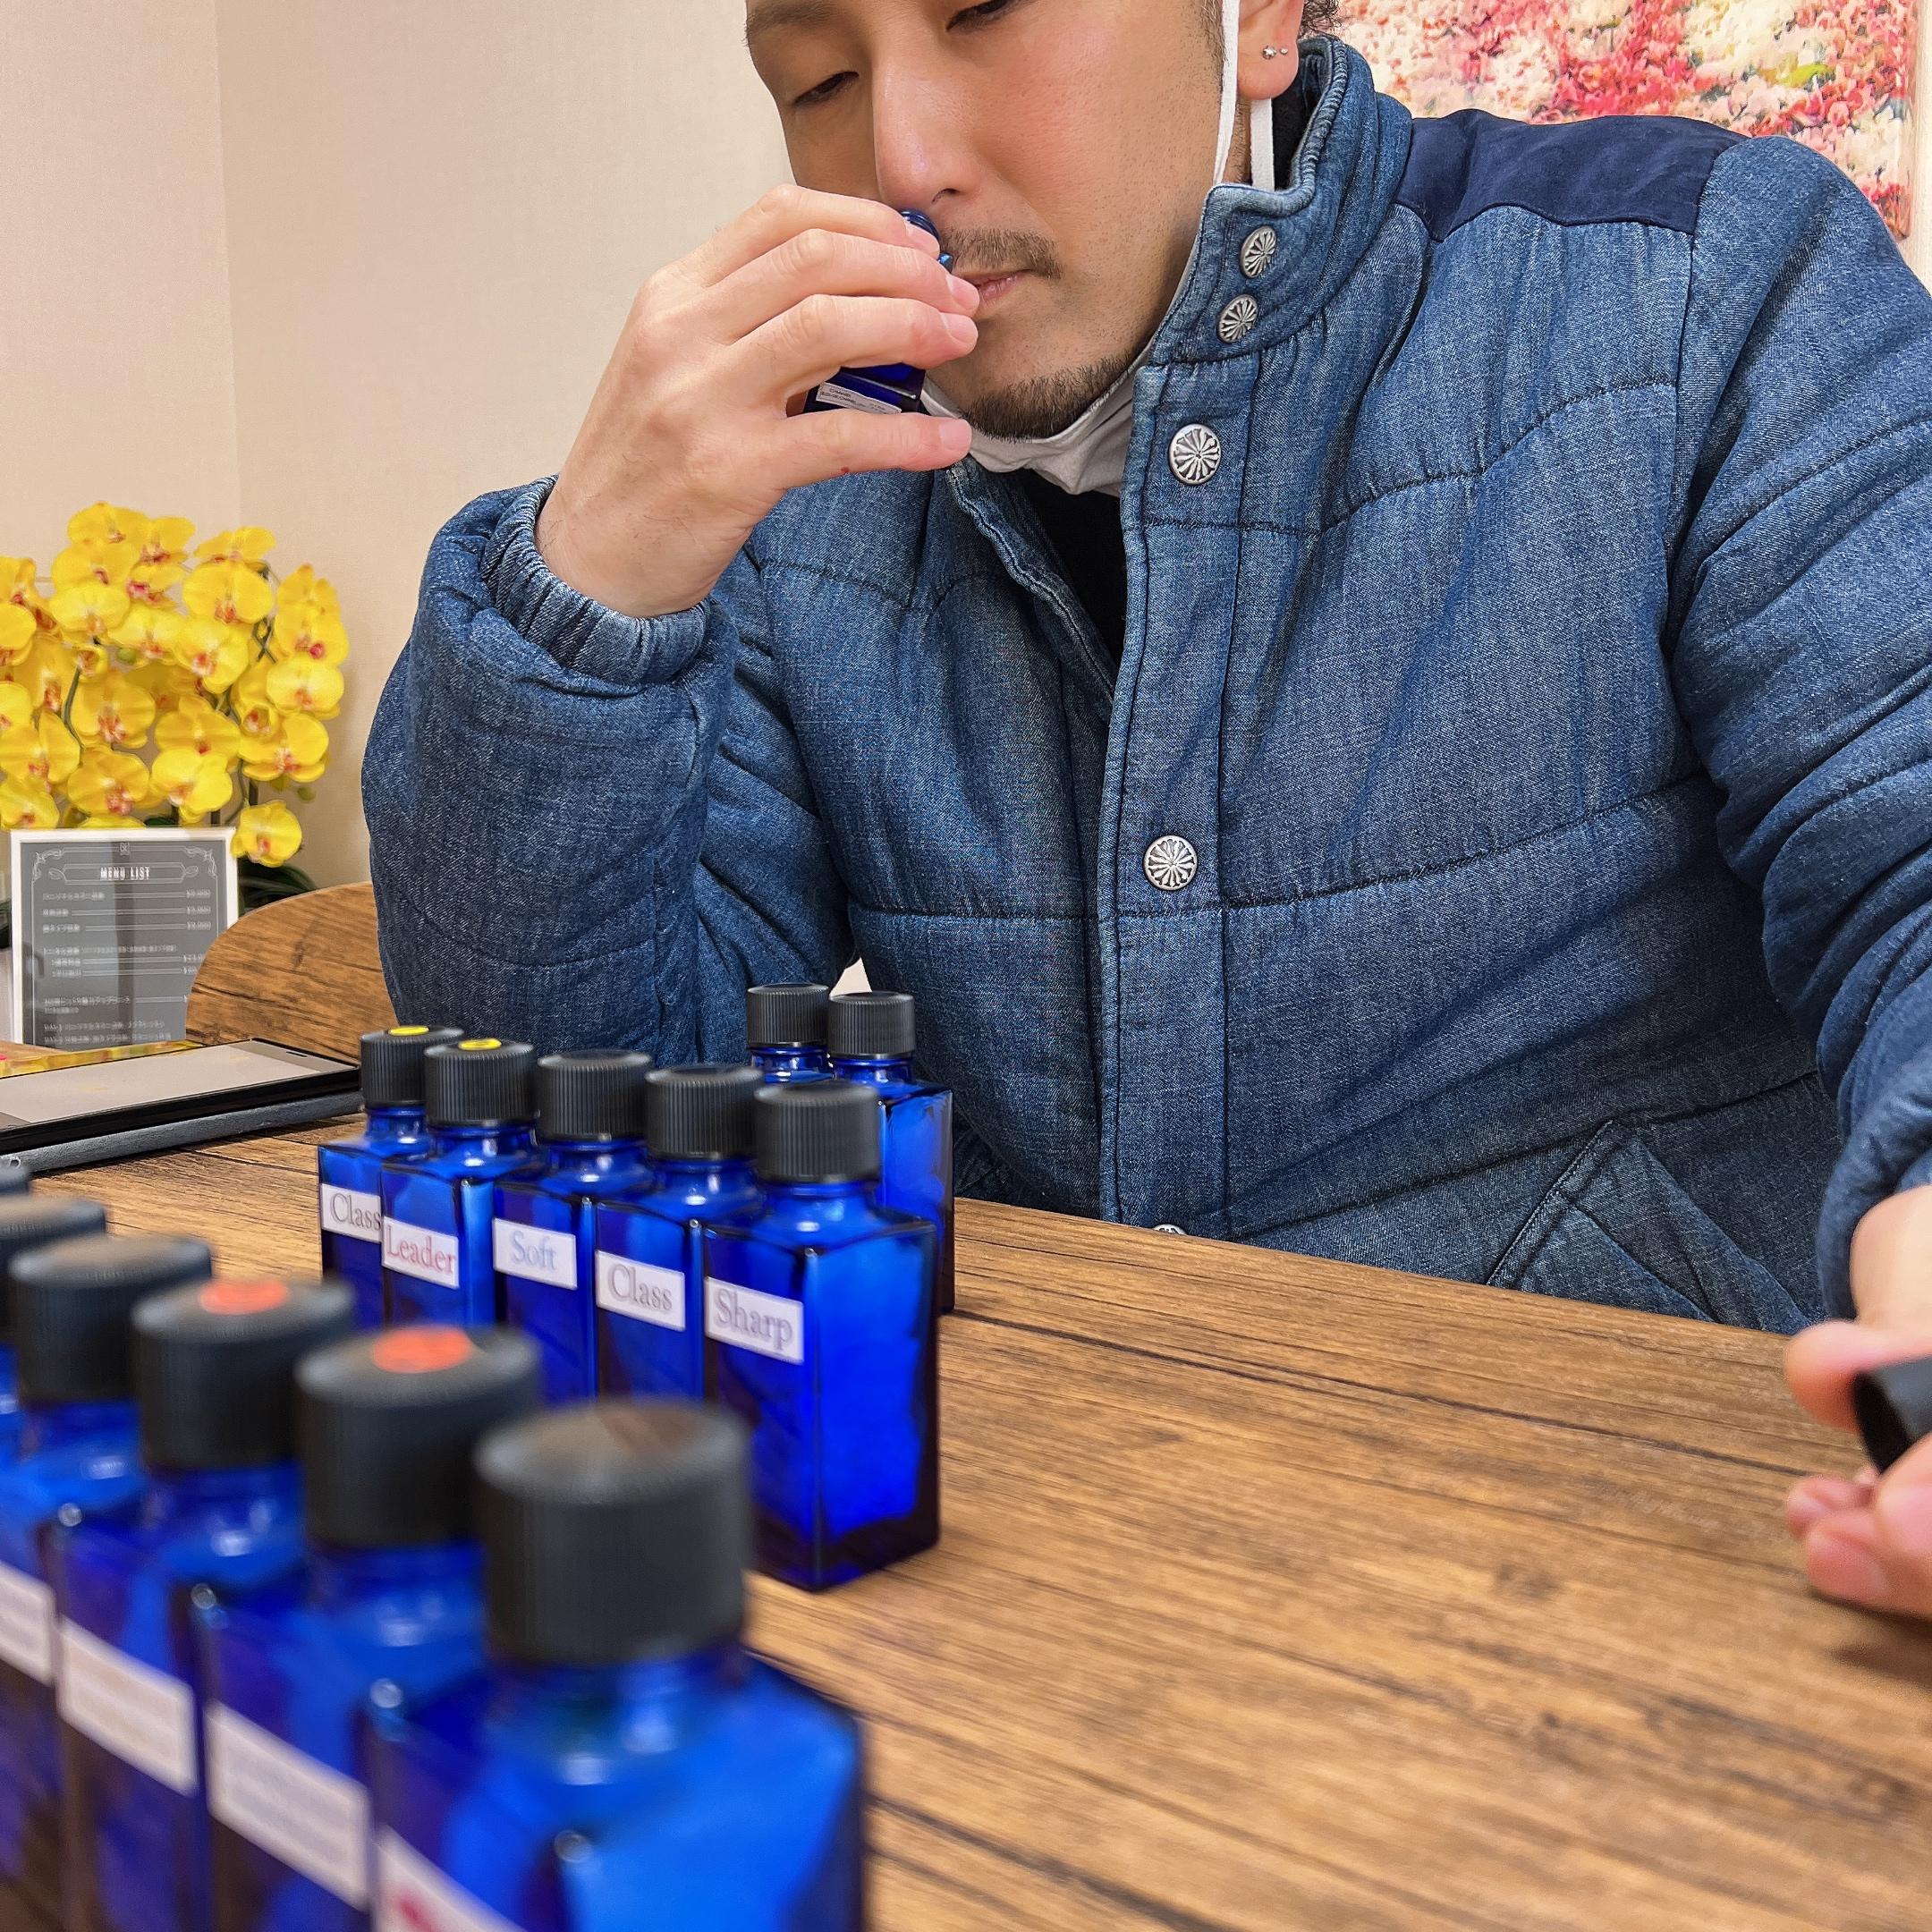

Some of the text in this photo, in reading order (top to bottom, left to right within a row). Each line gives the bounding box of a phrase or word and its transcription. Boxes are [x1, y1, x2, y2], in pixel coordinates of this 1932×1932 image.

[101, 866, 150, 880] MENU LIST
[331, 1192, 381, 1231] Class
[386, 1225, 456, 1274] Leader
[511, 1231, 555, 1270] Soft
[608, 1264, 673, 1310] Class
[716, 1288, 792, 1351] Sharp
